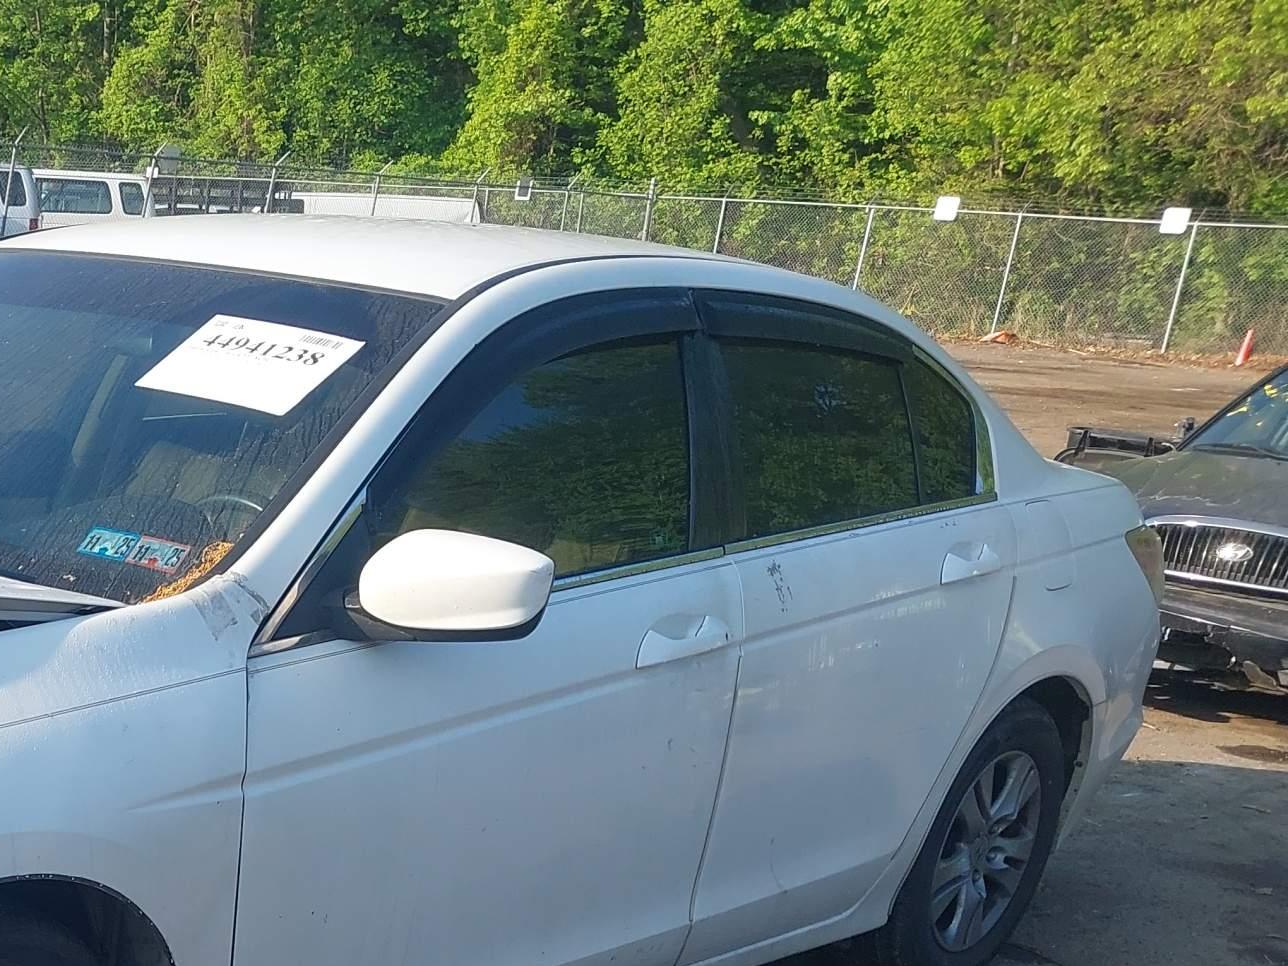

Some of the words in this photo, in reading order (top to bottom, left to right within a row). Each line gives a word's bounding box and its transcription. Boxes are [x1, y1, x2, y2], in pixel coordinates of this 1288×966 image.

[202, 334, 326, 366] 44941238
[83, 534, 102, 551] 11
[113, 537, 136, 556] 25
[132, 544, 151, 562] 11
[164, 548, 186, 567] 25
